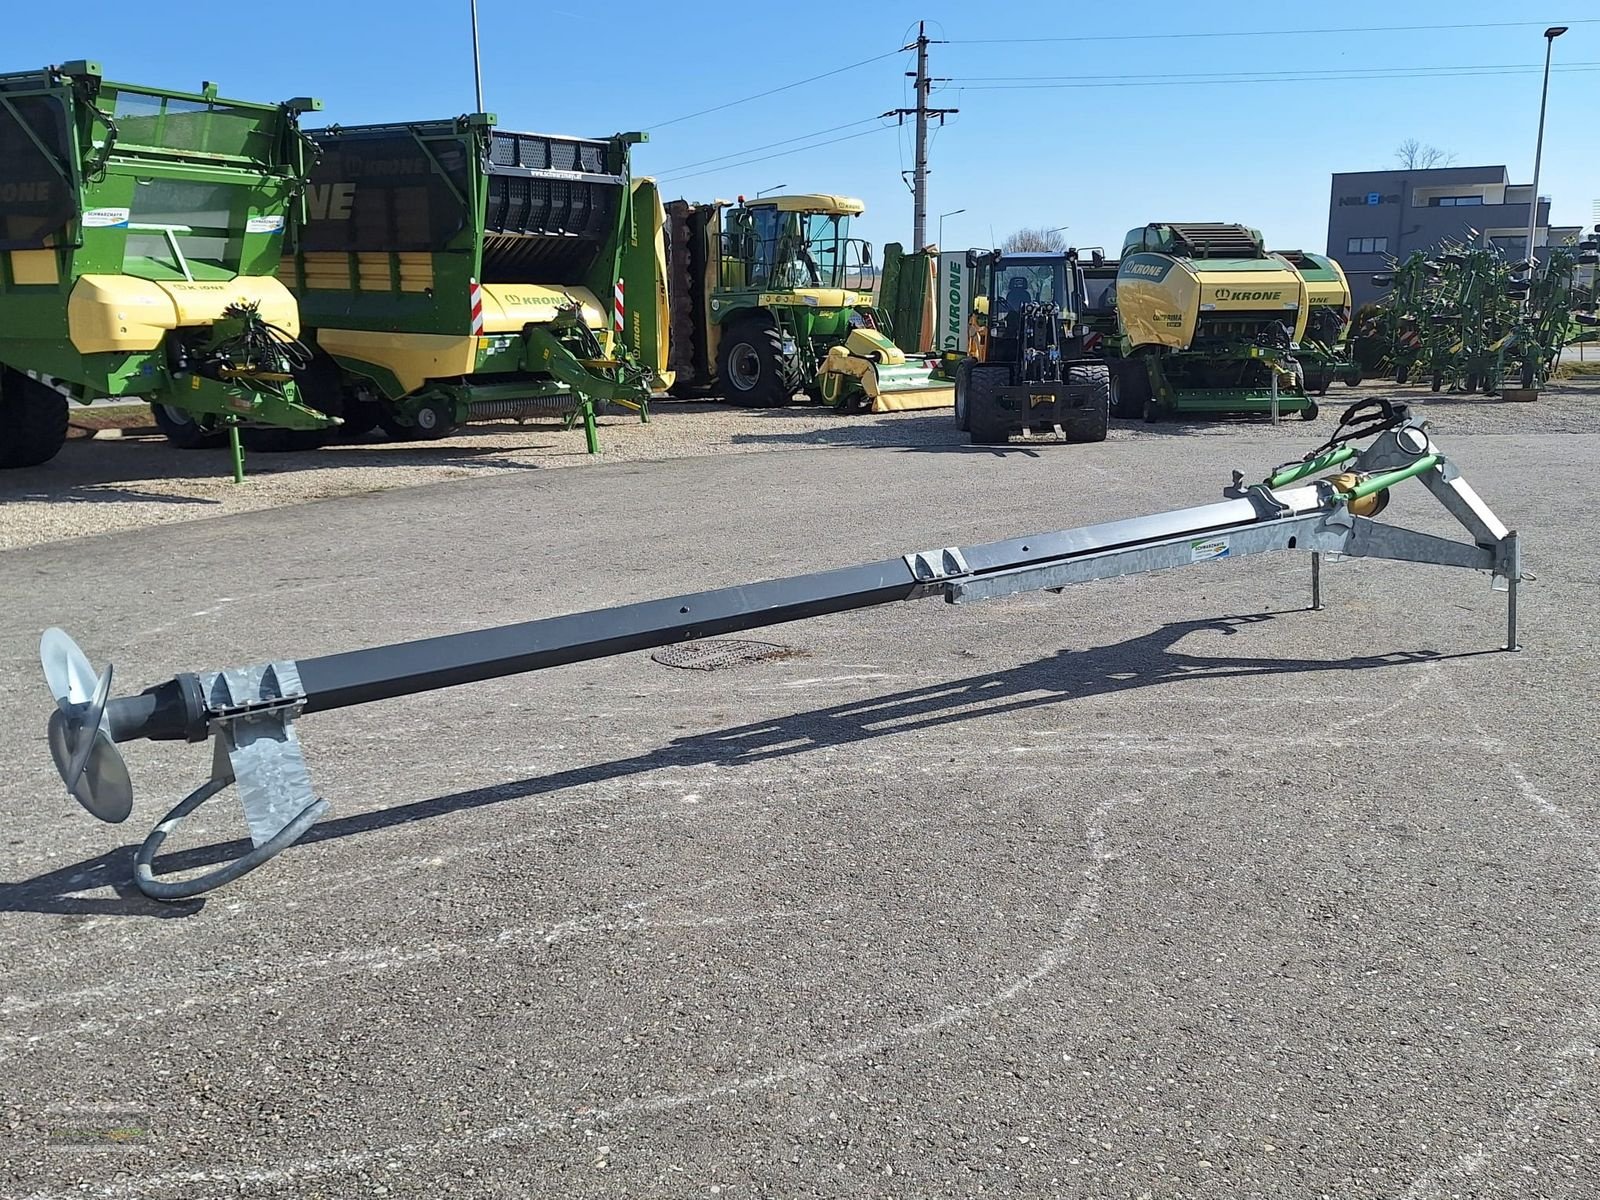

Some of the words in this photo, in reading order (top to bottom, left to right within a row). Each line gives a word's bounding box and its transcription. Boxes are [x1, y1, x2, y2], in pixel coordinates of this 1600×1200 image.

[1130, 263, 1164, 277] KRONE
[522, 296, 569, 305] KRONE
[949, 260, 961, 335] KRONE
[1230, 291, 1282, 301] KRONE
[633, 311, 642, 349] KRONE
